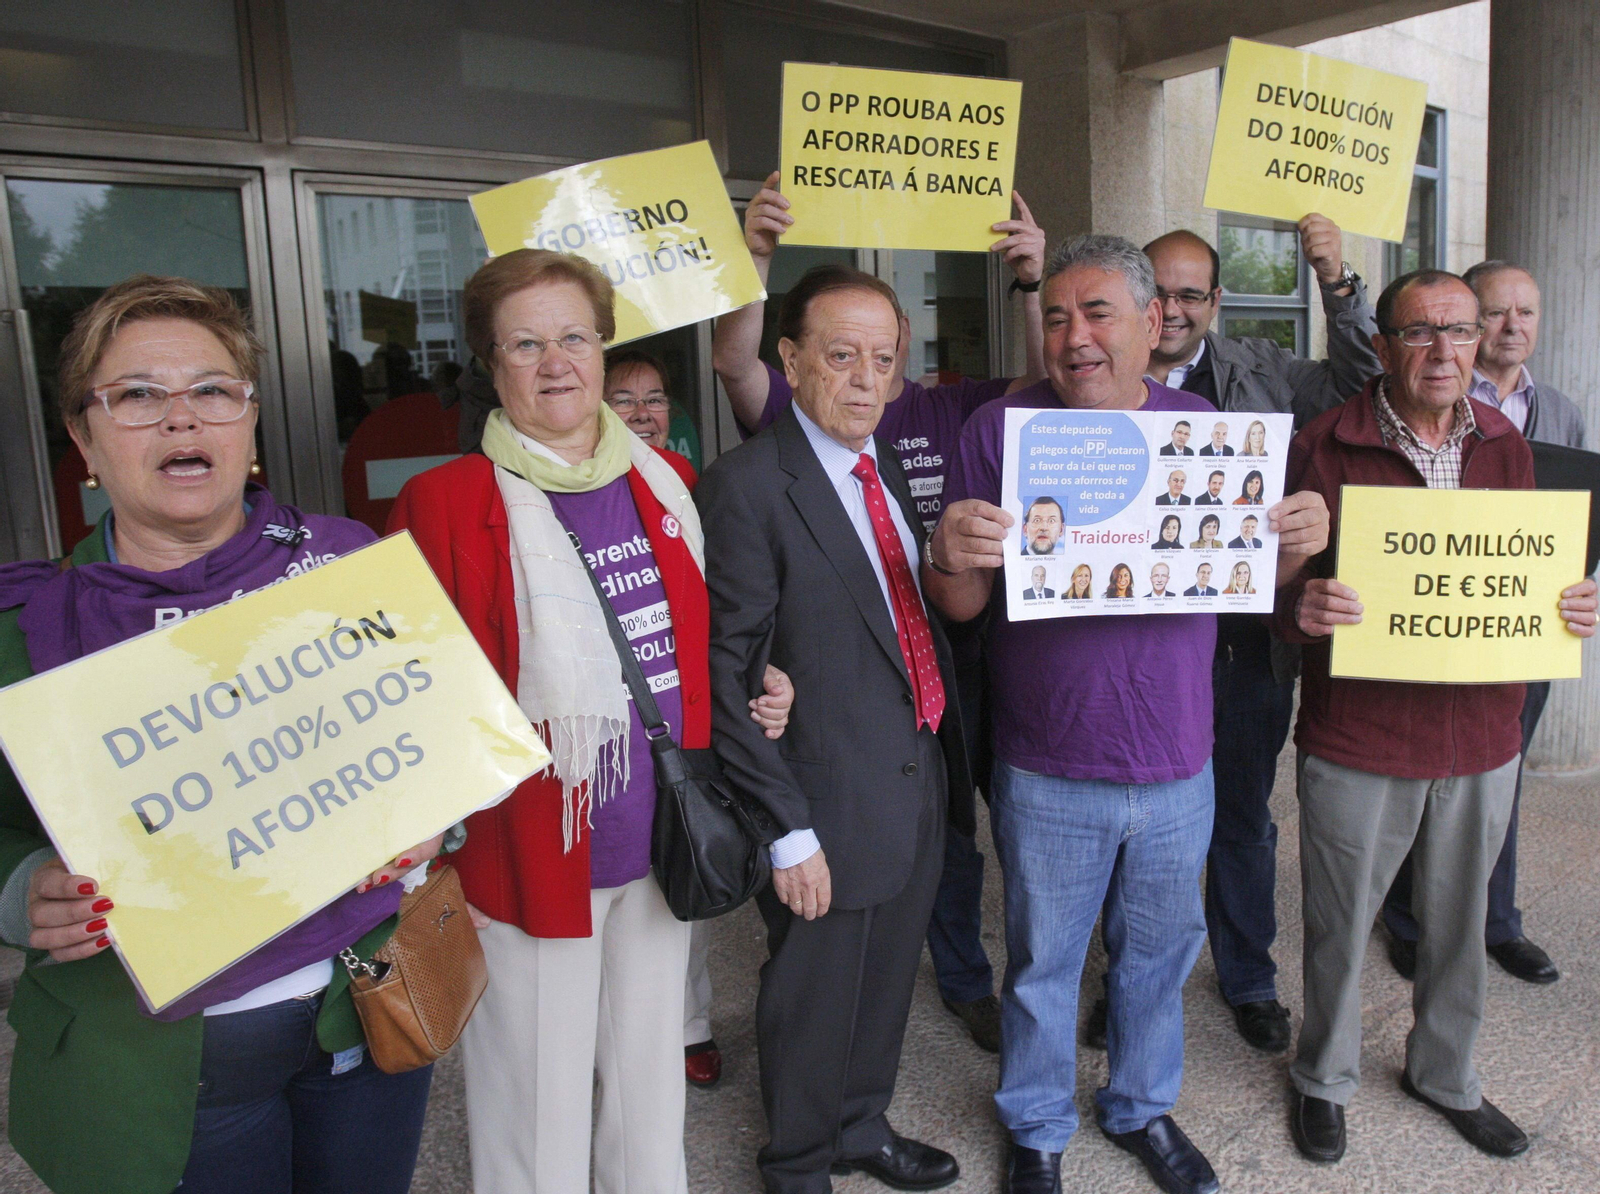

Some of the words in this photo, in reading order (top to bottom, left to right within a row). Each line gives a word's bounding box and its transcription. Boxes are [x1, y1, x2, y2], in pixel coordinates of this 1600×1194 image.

[802, 90, 820, 112] O
[829, 92, 860, 115] PP
[868, 95, 952, 122] ROUBA
[958, 103, 1005, 126] AOS
[1257, 82, 1393, 130] DEVOLUCIÓN
[802, 129, 980, 160] AFORRADORES
[987, 141, 999, 161] E
[1247, 118, 1283, 141] DO
[1290, 125, 1346, 155] 100%
[1351, 138, 1390, 165] DOS
[793, 165, 895, 191] RESCATA
[901, 166, 918, 192] Á
[926, 173, 1003, 197] BANCA
[1264, 158, 1365, 195] AFORROS
[537, 199, 689, 252] GOBERNO
[1031, 424, 1058, 435] Estes
[1059, 424, 1113, 438] deputados
[1030, 444, 1069, 457] galegos
[1070, 444, 1084, 455] do
[1086, 441, 1105, 455] PP
[1107, 446, 1145, 455] votaron
[1029, 463, 1036, 471] a
[1038, 461, 1064, 471] favor
[1066, 461, 1079, 471] da
[1081, 461, 1096, 471] Lei
[1097, 462, 1116, 474] que
[1118, 462, 1136, 471] nos
[1029, 475, 1059, 485] rouba
[1060, 477, 1072, 485] os
[1115, 475, 1128, 485] de
[1079, 504, 1099, 514] vida
[1080, 490, 1092, 500] de
[1094, 490, 1117, 500] toda
[1118, 492, 1125, 500] a
[1071, 529, 1150, 545] Traidores!
[1383, 532, 1436, 555] 500
[1446, 528, 1555, 557] MILLÓNS
[1414, 573, 1450, 597] DE
[1460, 575, 1476, 597] €
[1483, 574, 1527, 597] SEN
[651, 610, 671, 624] dos
[1389, 613, 1542, 638] RECUPERAR
[101, 609, 397, 769] DEVOLUCIÓN
[131, 771, 213, 835] DO
[222, 705, 341, 790] 100%
[342, 658, 433, 725] DOS
[225, 731, 425, 870] AFORROS
